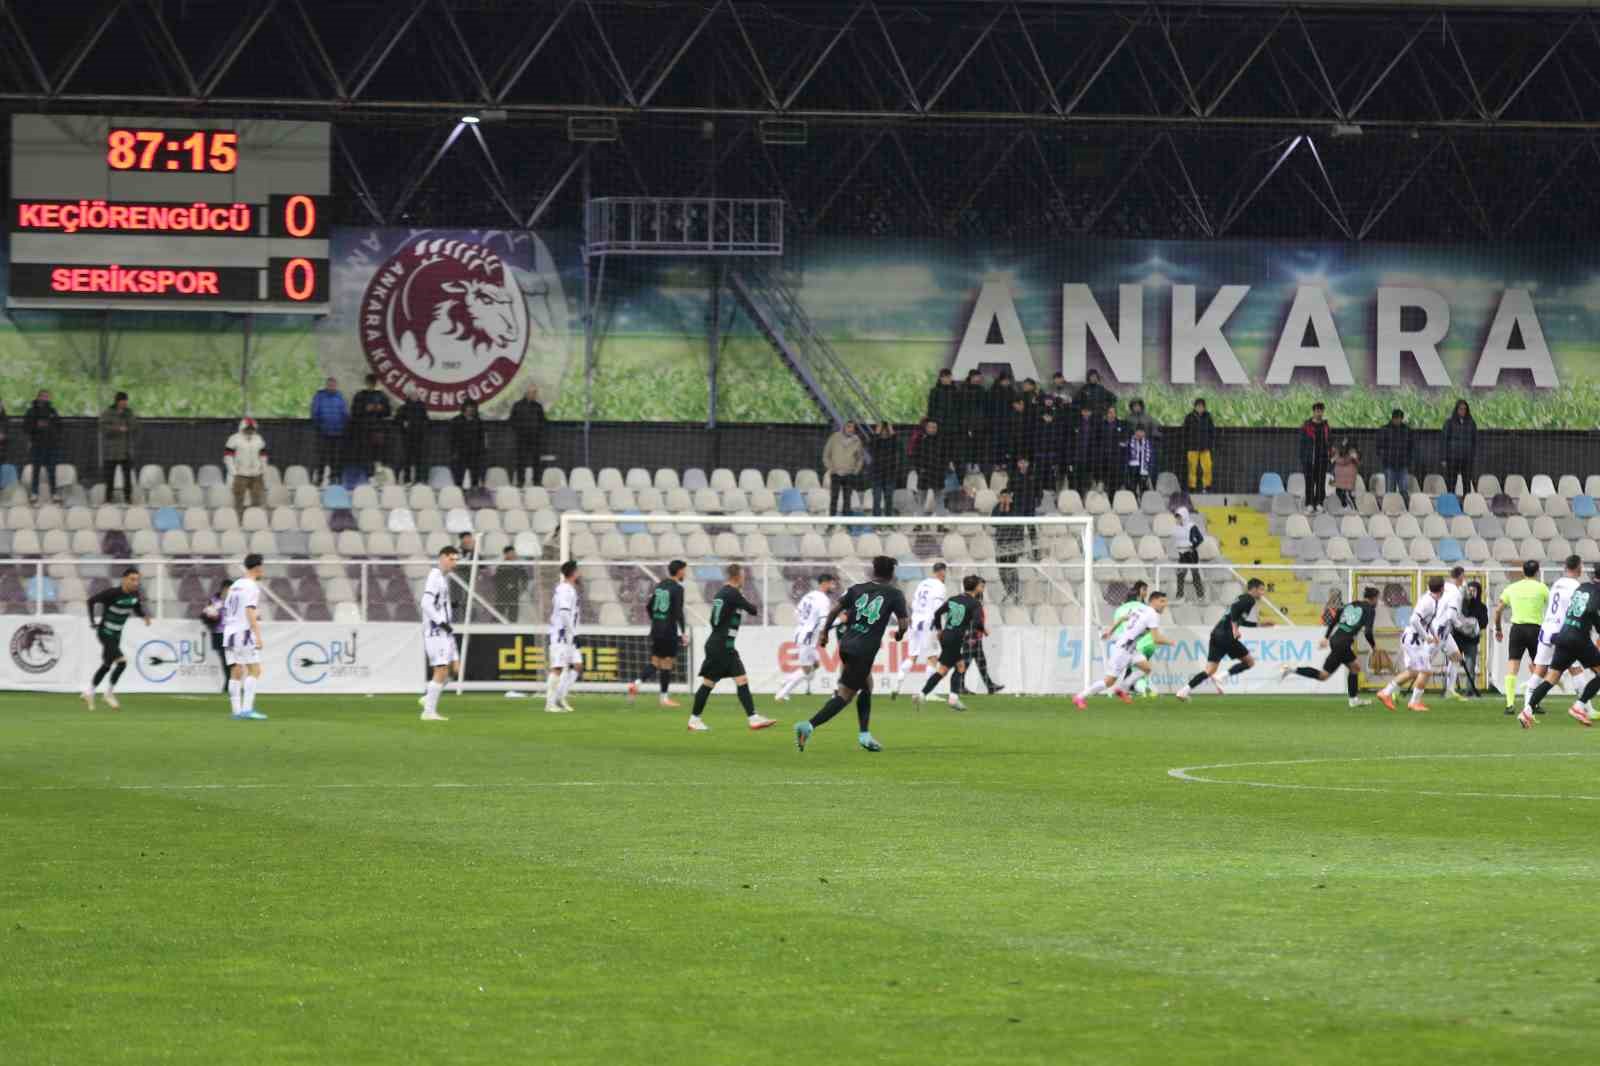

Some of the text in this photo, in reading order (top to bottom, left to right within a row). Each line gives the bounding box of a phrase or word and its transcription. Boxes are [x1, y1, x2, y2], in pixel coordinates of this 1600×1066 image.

[107, 130, 238, 172] 87:15
[19, 194, 316, 237] KEÇİÖRENGÜCÜ 0
[51, 258, 315, 301] SERİKSPOR 0
[366, 261, 405, 341] ANKARA
[951, 283, 1561, 388] ANKARA
[1551, 592, 1560, 616] 8
